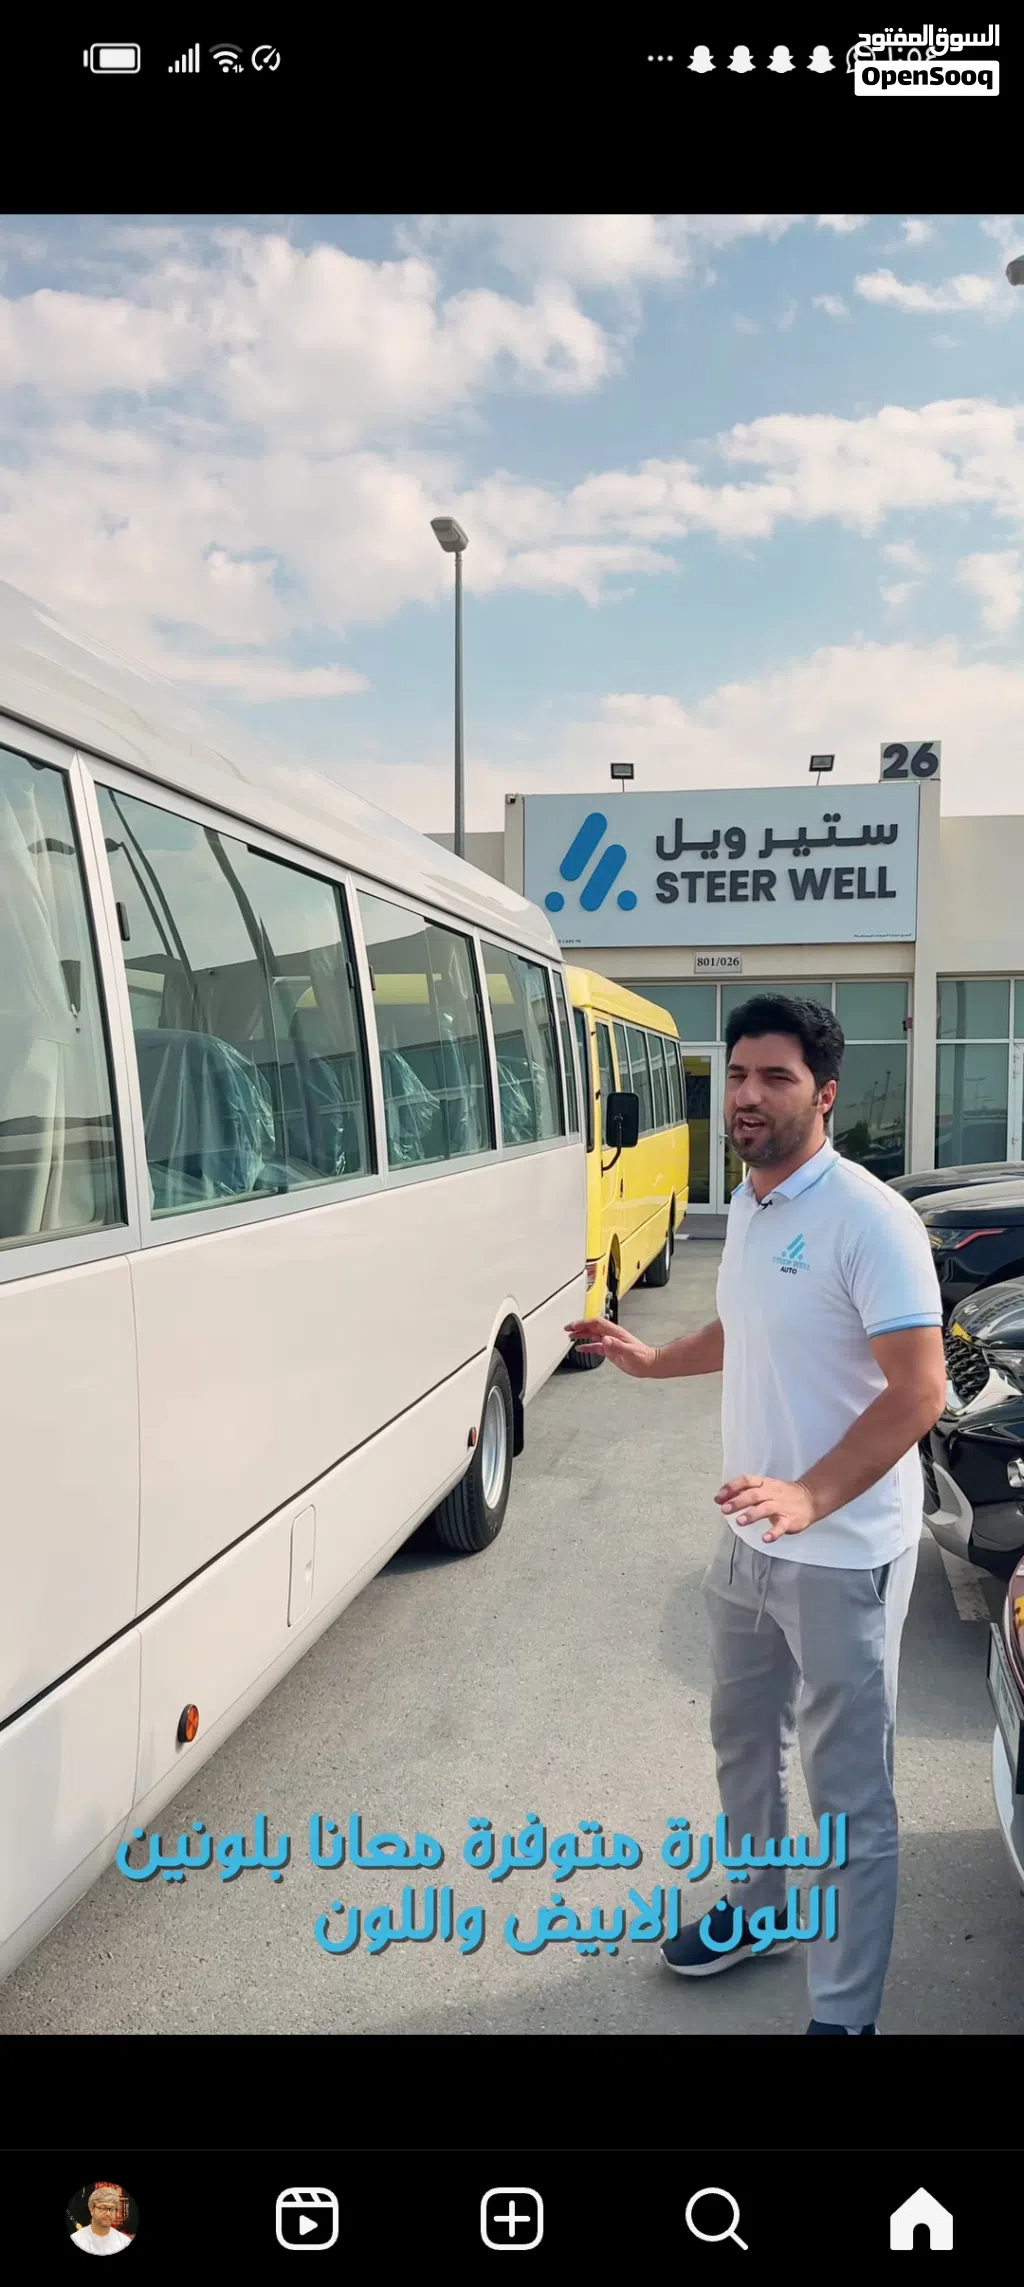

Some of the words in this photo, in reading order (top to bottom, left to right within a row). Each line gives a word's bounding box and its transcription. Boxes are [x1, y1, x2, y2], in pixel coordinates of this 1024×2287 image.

[882, 742, 940, 780] 26
[655, 817, 748, 862] ويل
[757, 812, 899, 859] ستير
[655, 868, 778, 905] STEER
[786, 865, 898, 901] WELL
[696, 957, 740, 967] 801/026
[780, 1265, 798, 1275] AUTO
